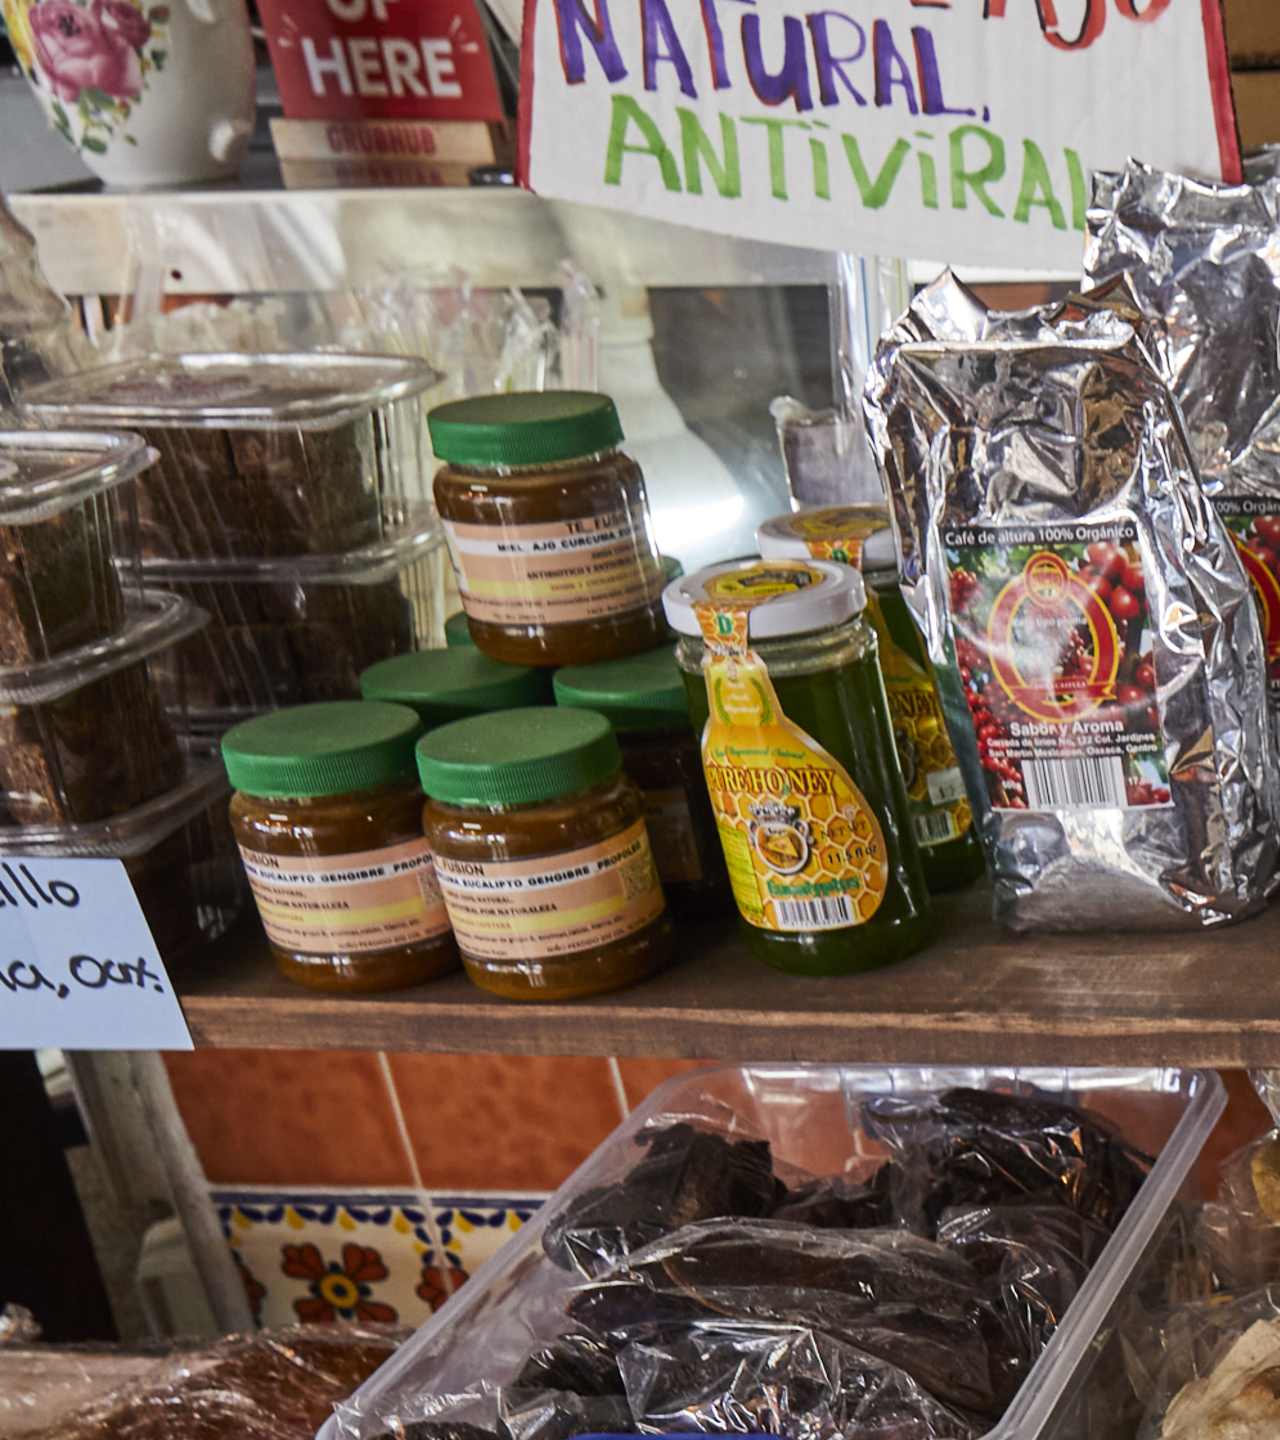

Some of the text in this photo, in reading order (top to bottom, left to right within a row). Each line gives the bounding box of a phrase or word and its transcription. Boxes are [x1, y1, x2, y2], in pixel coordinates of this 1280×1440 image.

[300, 37, 462, 97] HERE
[945, 525, 1134, 546] Café de altura 100% Orgánico
[1010, 721, 1056, 736] Sabor
[1072, 720, 1124, 734] Aroma
